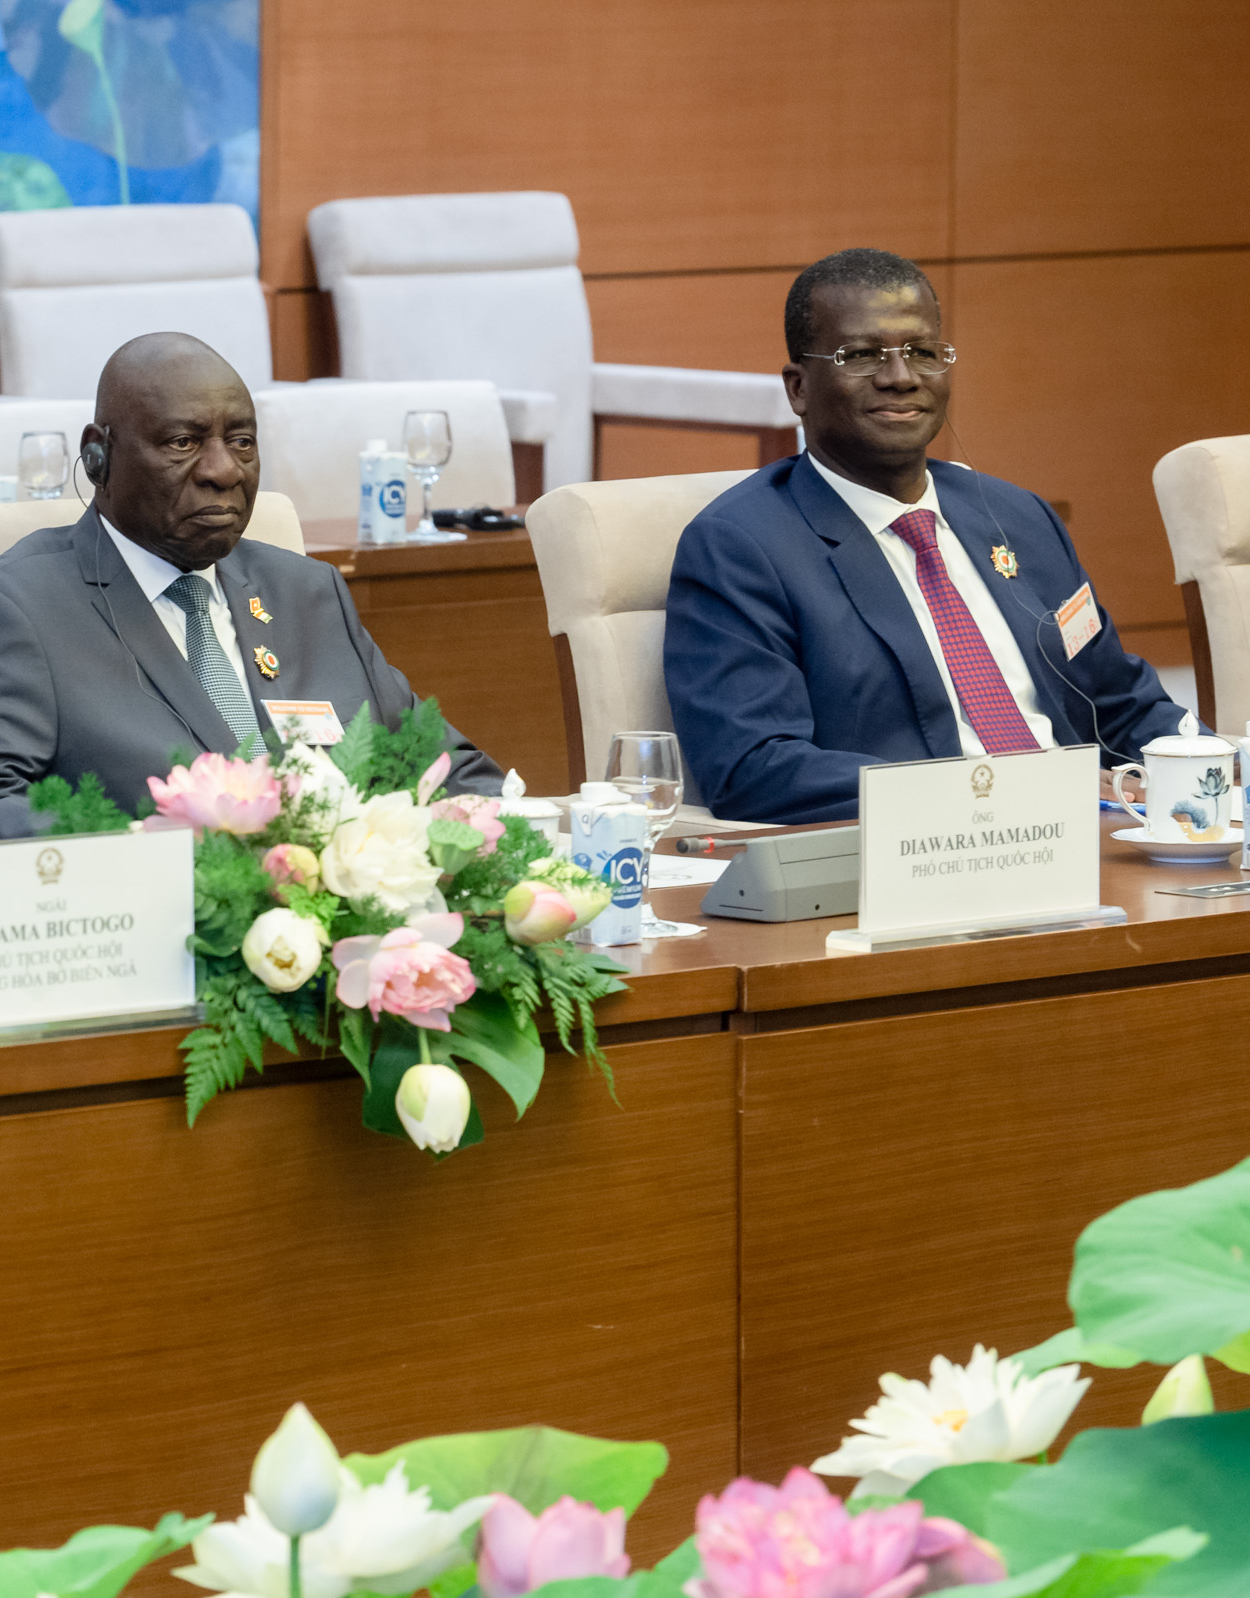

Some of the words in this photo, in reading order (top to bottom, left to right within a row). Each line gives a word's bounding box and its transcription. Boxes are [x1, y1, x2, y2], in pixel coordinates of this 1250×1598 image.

[972, 810, 994, 825] ÔNG
[900, 833, 977, 857] DIAWARA
[981, 822, 1065, 848] MAMADOU
[611, 857, 644, 885] ICY
[912, 859, 936, 878] PHÓ
[939, 856, 964, 875] CHỦ
[967, 856, 994, 874] TỊCH
[997, 849, 1031, 870] QUỐC
[1033, 846, 1054, 865] HỘI
[46, 913, 135, 939] BICTOGO
[16, 949, 50, 968] TỊCH
[97, 939, 123, 960] HỘI
